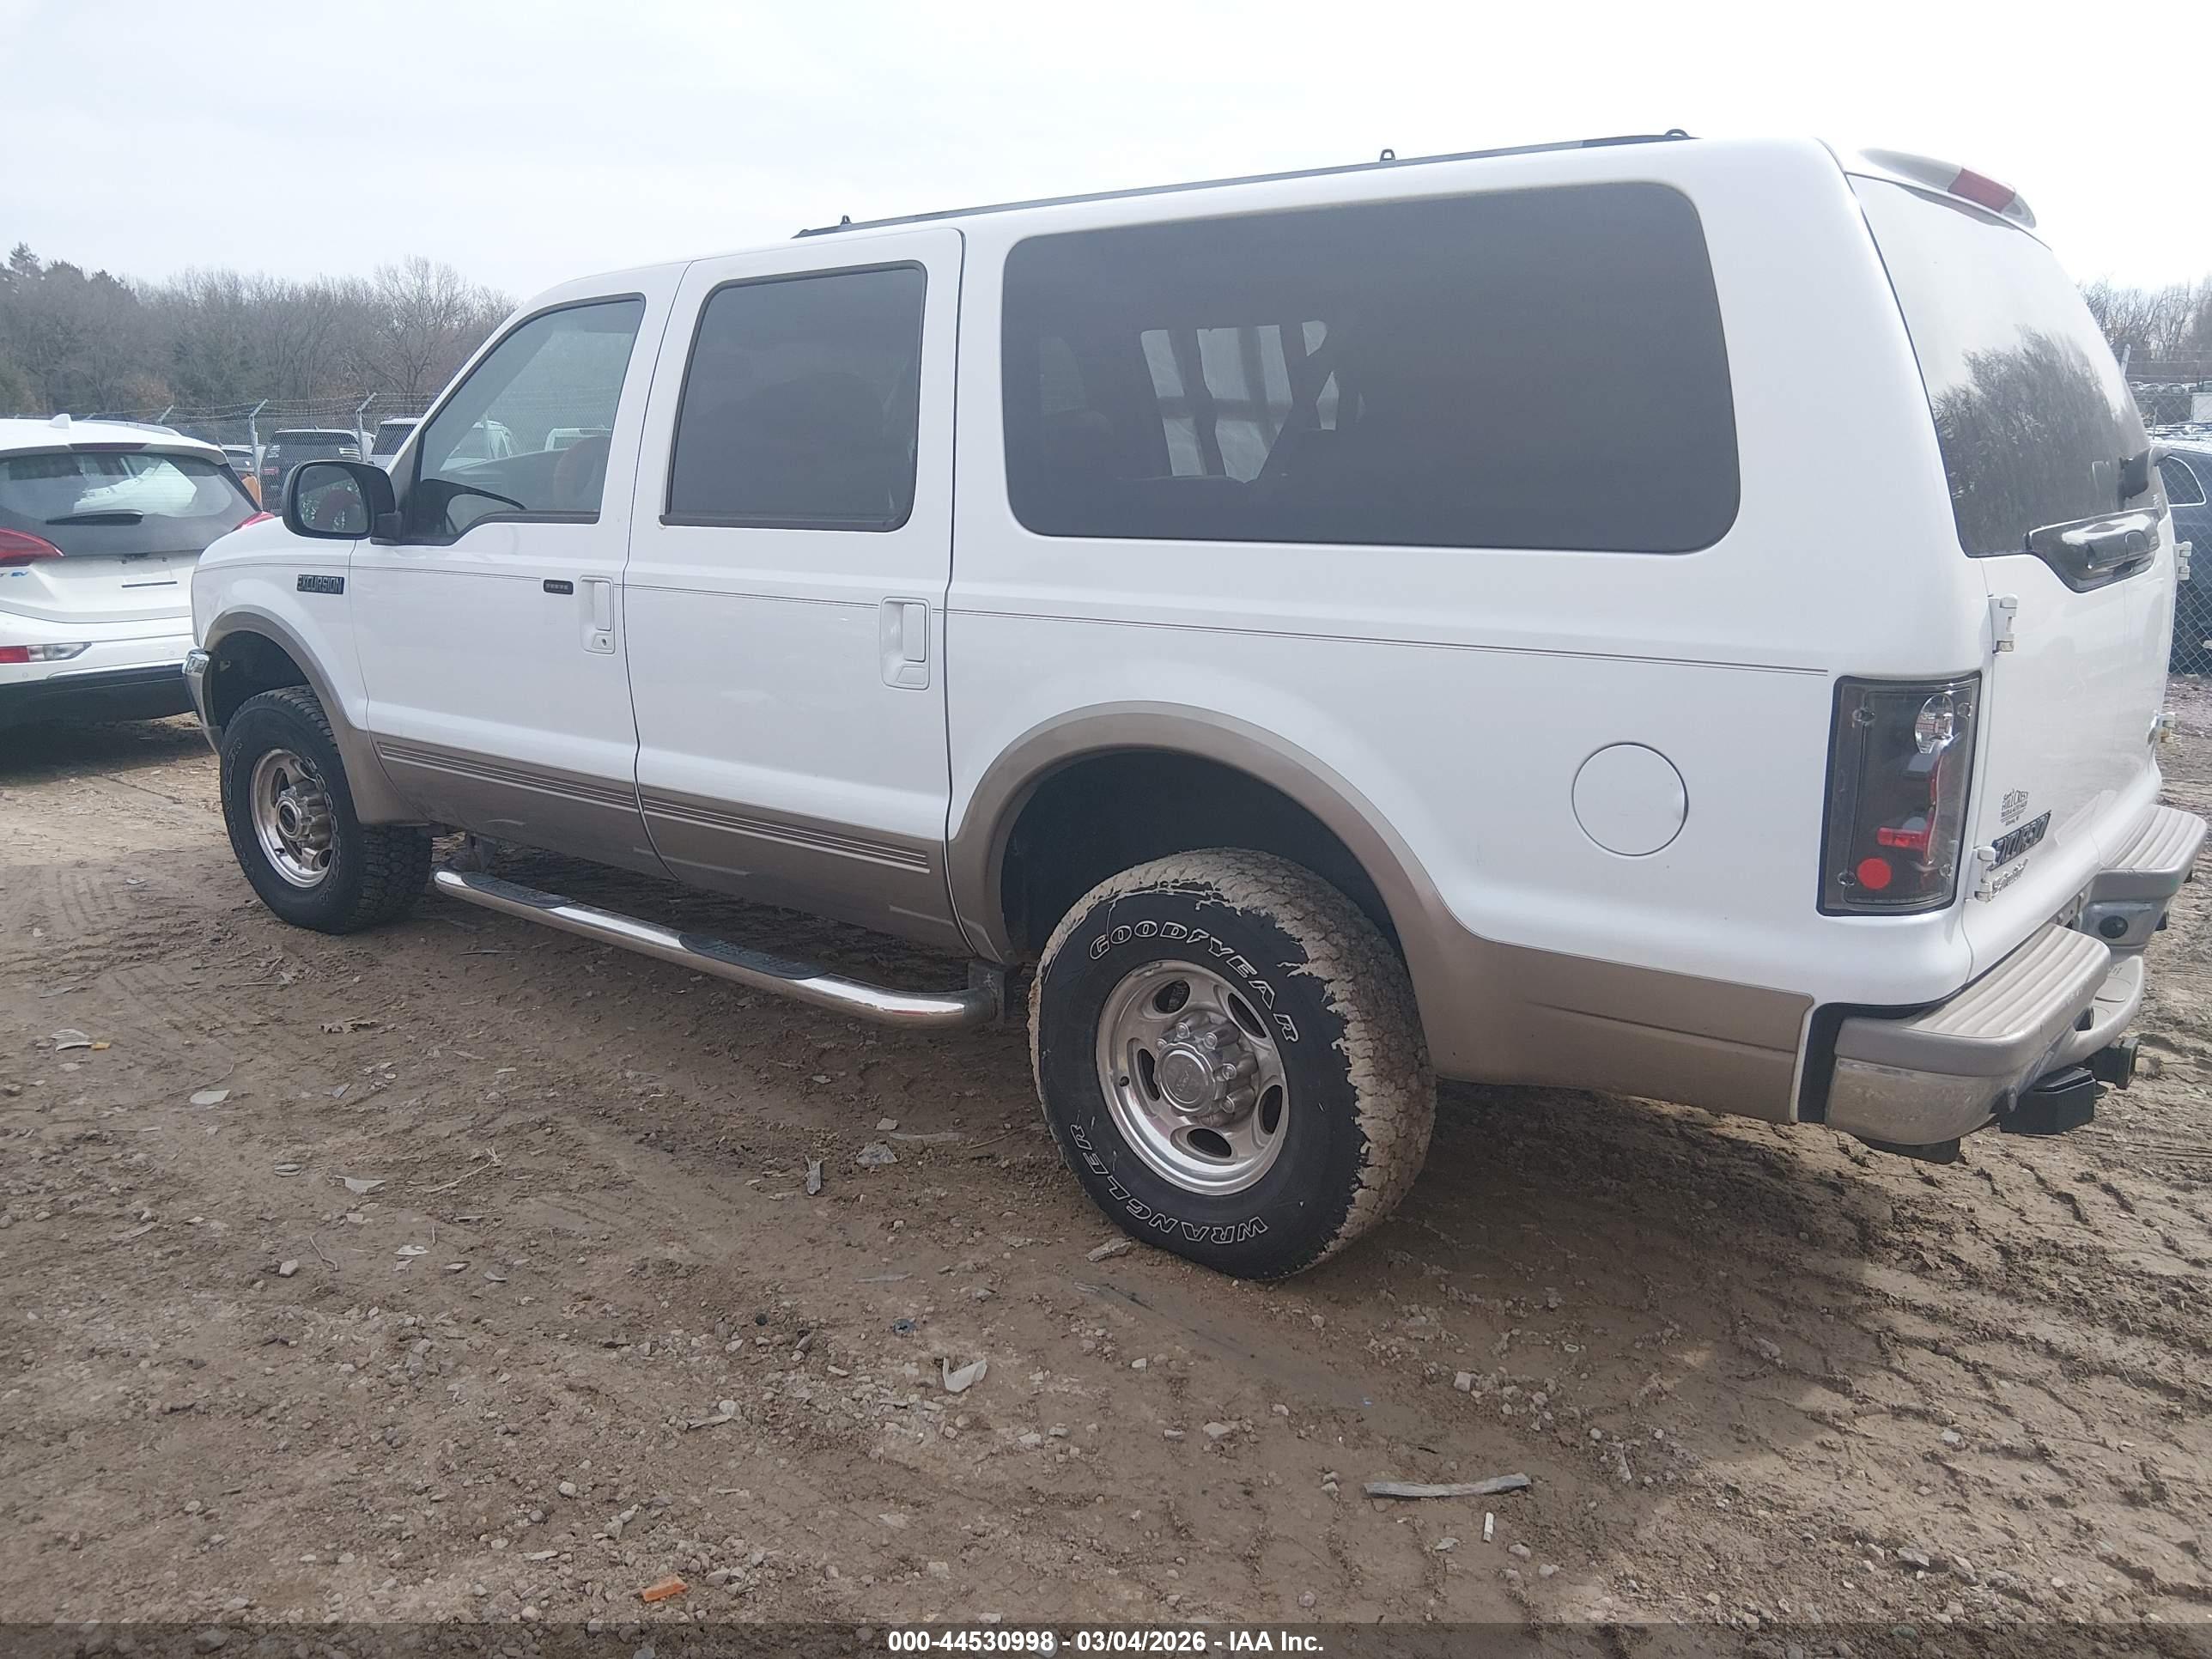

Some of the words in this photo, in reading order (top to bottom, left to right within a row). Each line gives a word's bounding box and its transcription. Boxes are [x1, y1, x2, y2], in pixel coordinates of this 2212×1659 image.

[298, 575, 343, 594] EXCURSION
[1089, 920, 1299, 1043] GOODYEAR
[1070, 1123, 1269, 1245] WRANGLER
